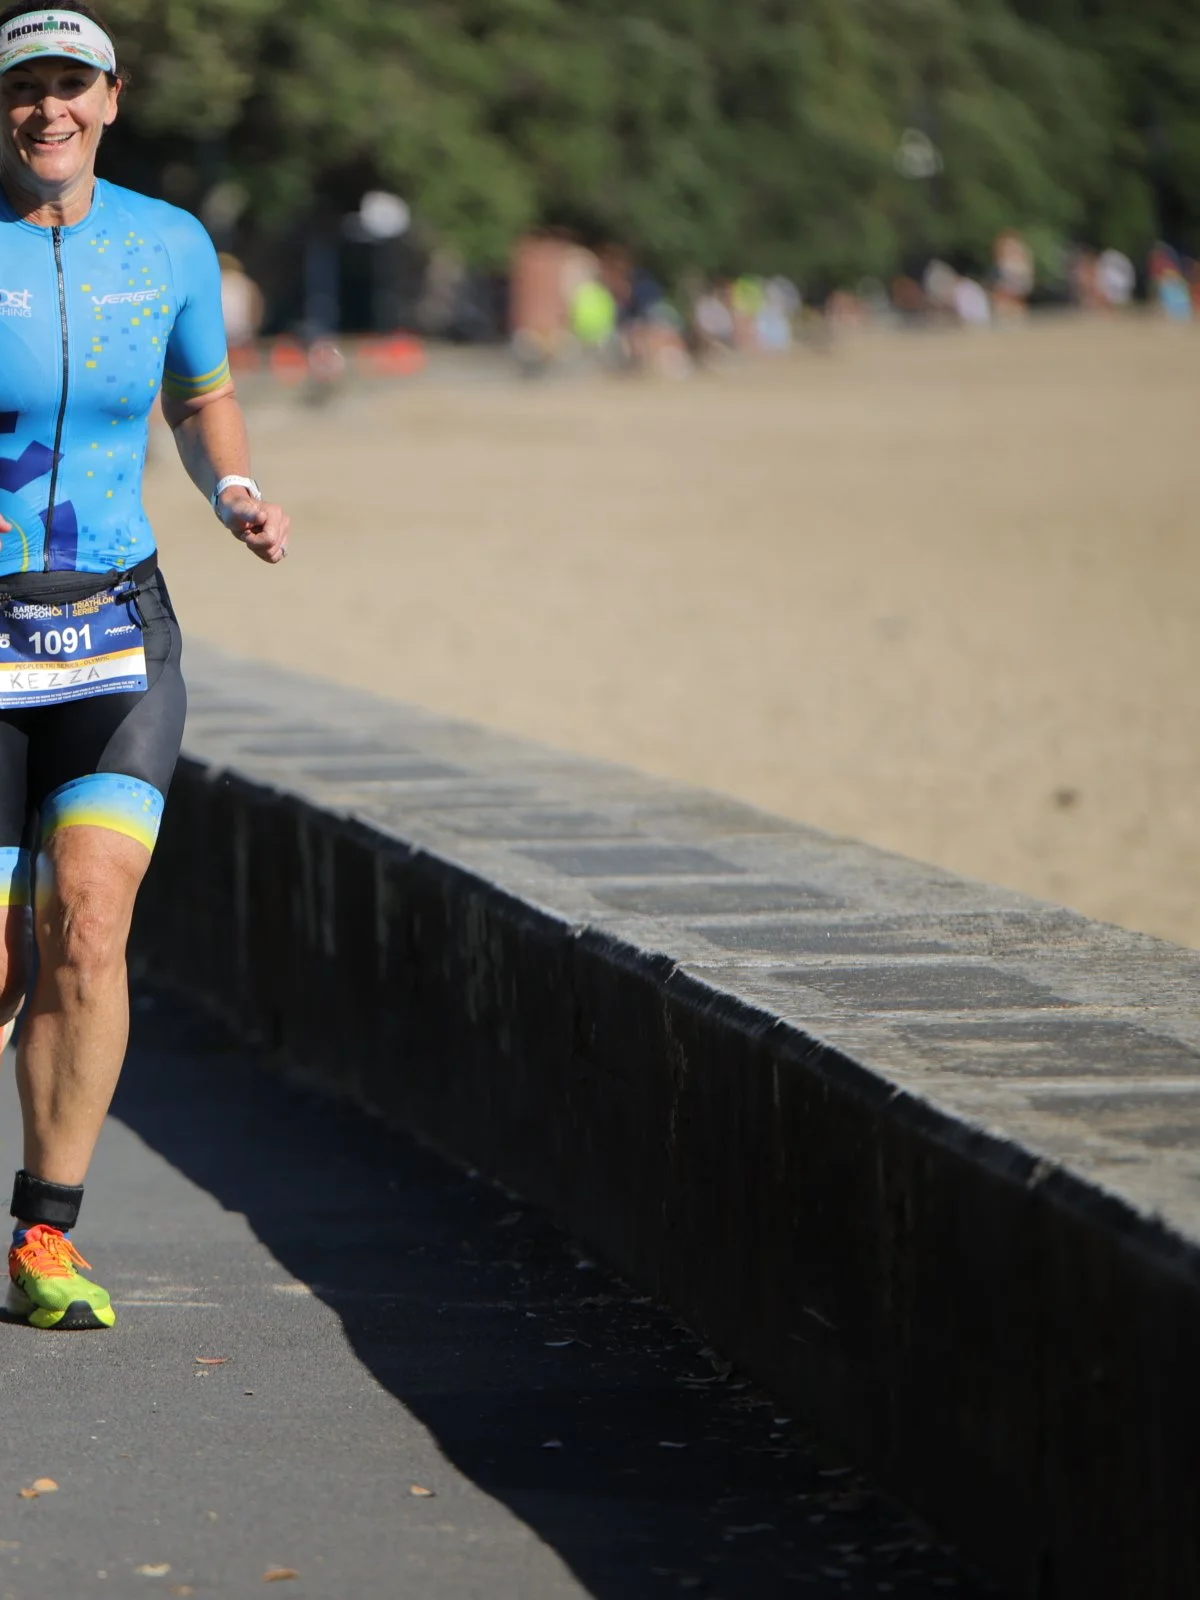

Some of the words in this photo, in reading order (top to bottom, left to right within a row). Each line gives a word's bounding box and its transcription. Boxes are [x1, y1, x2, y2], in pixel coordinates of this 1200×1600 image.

[7, 16, 80, 41] IRONMAN
[91, 289, 159, 305] VERGE
[72, 595, 115, 609] TRIATHLON
[4, 610, 52, 620] THOMPSON
[72, 605, 99, 617] SERIES
[28, 623, 92, 655] 1091
[57, 661, 79, 669] SERIES
[83, 655, 110, 666] OLYMPIC
[10, 666, 100, 689] KEZZA
